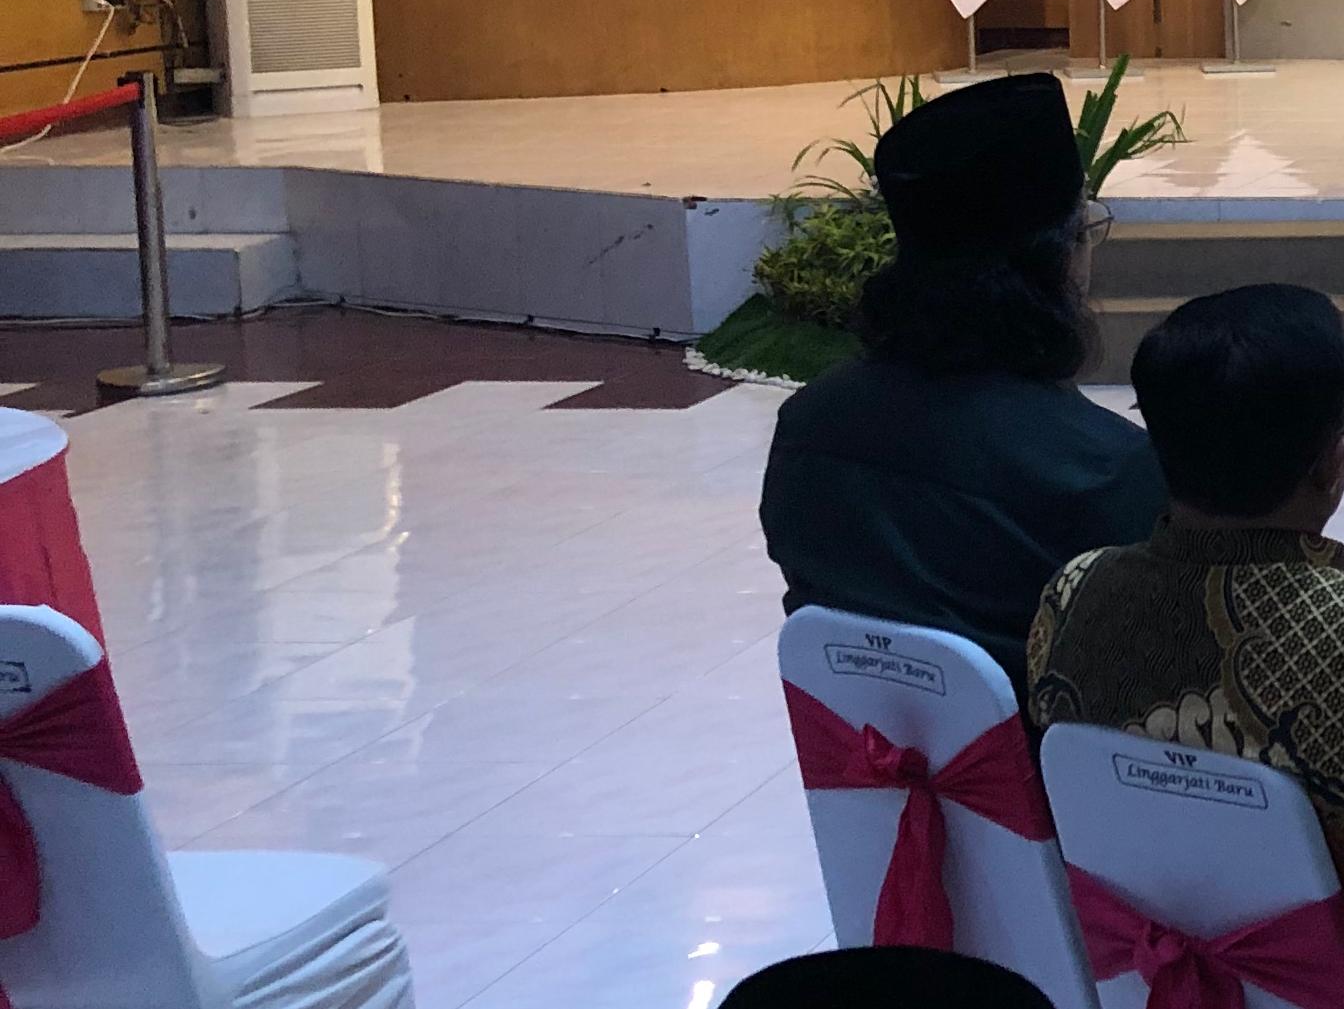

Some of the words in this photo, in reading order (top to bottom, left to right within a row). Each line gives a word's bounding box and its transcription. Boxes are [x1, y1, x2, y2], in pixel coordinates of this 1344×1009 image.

[865, 633, 892, 650] VIP
[1164, 750, 1198, 767] VIP
[1127, 763, 1210, 791] Linggarjati
[1214, 779, 1254, 798] Baru
